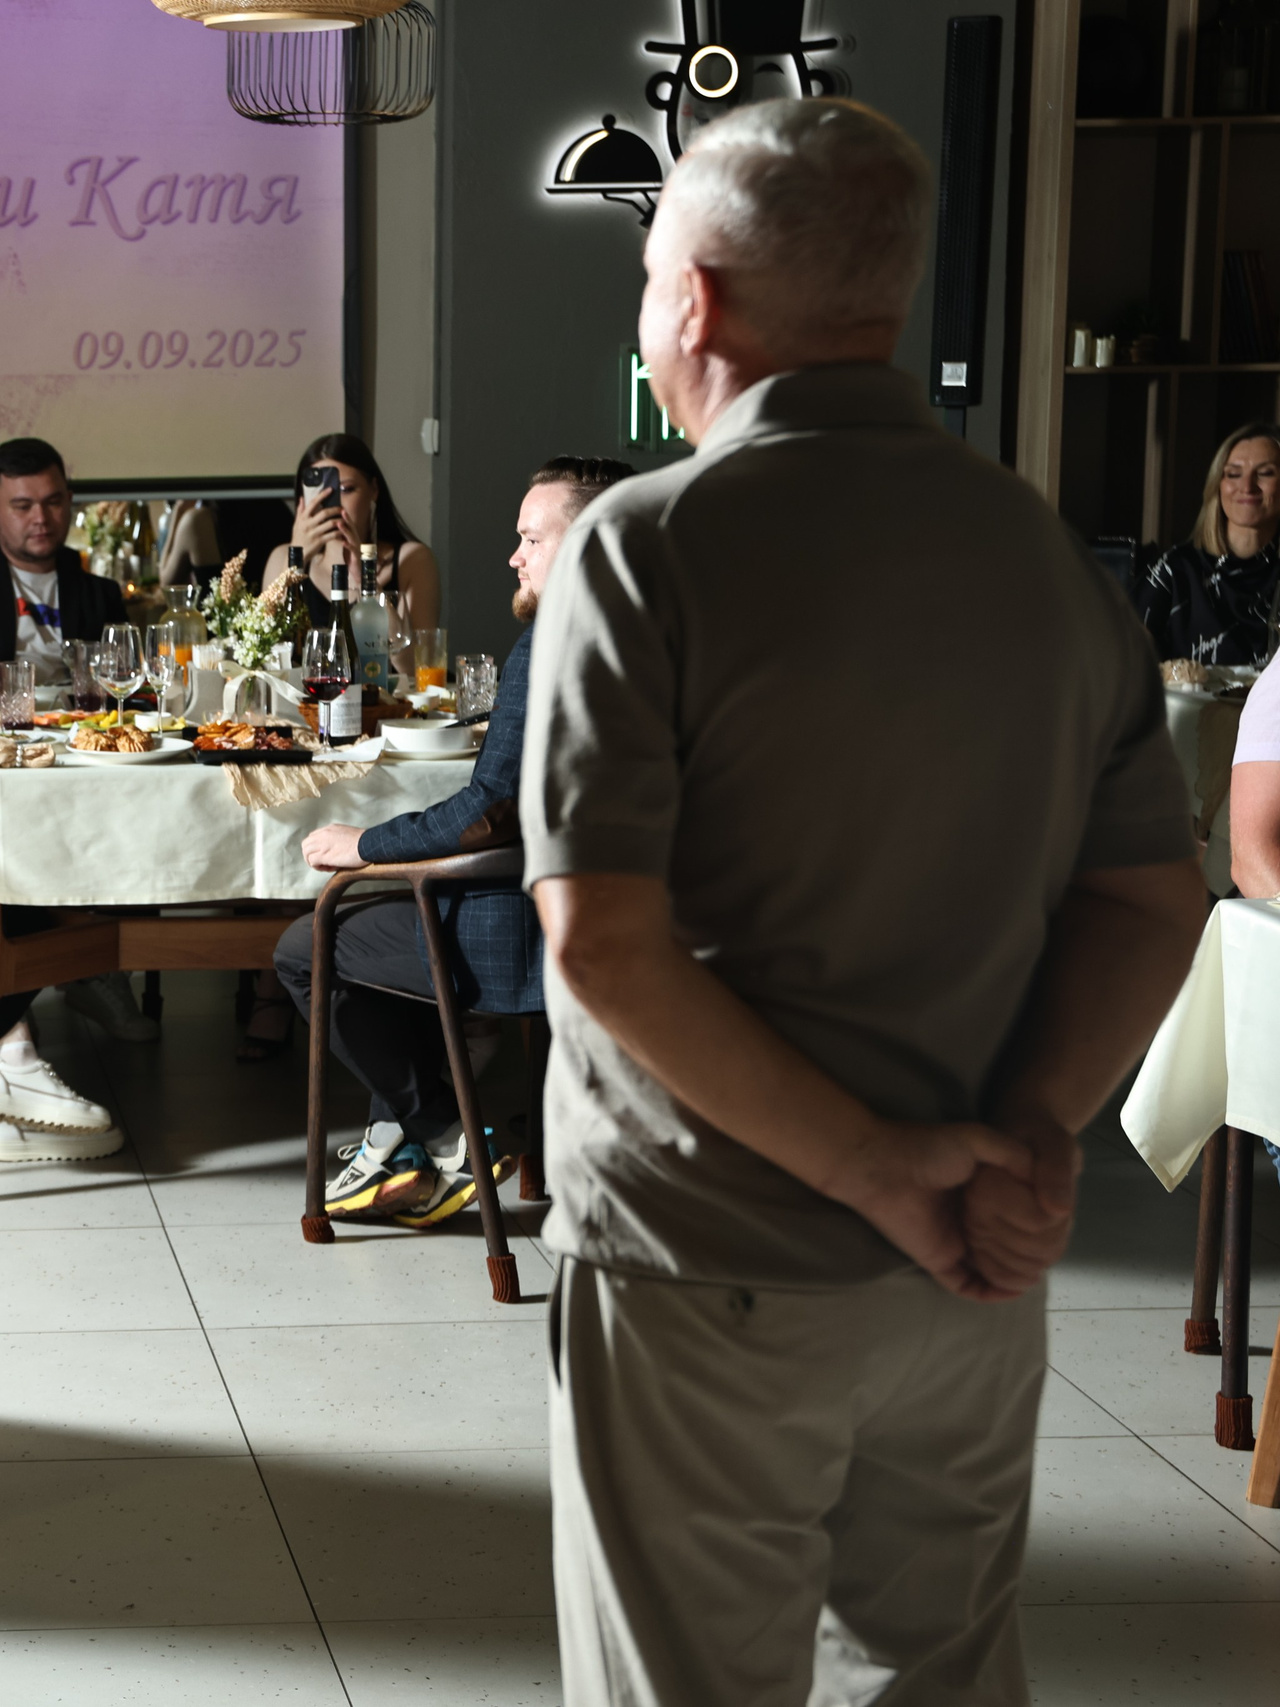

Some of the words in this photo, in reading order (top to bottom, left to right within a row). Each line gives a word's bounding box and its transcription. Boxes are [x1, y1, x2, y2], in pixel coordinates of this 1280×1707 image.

[64, 154, 303, 242] Катя
[72, 328, 308, 371] 09.09.2025
[1191, 633, 1228, 665] Hugo
